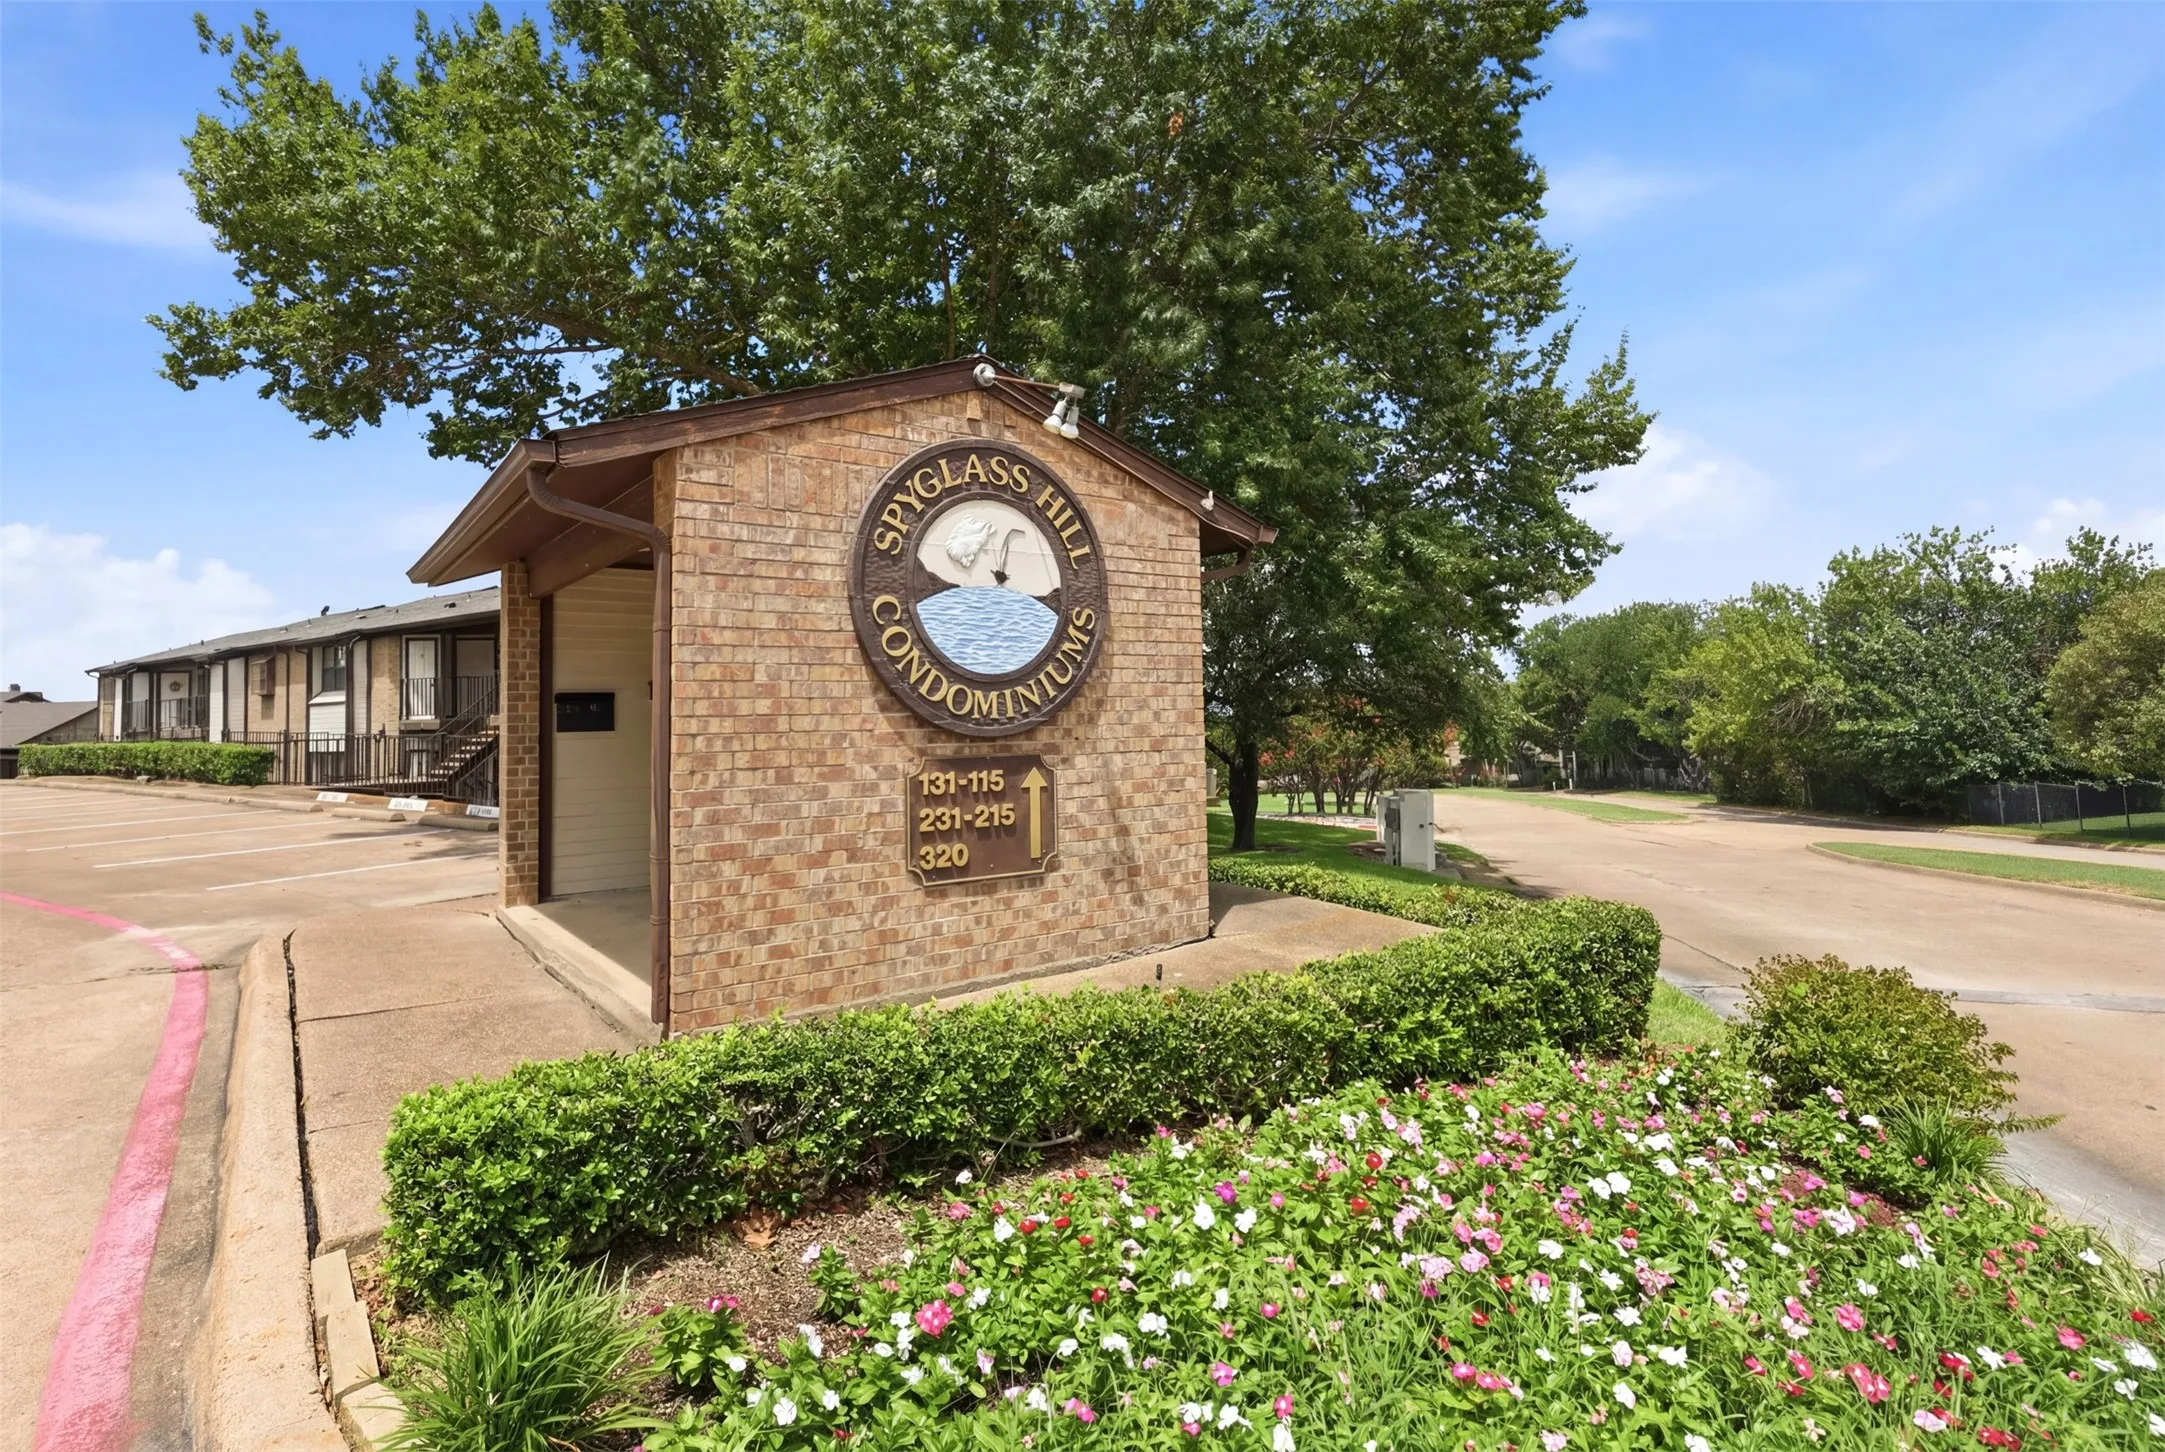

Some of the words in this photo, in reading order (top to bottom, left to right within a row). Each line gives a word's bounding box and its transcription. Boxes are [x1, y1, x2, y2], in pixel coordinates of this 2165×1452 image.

[874, 453, 1030, 556] SPYGLASS
[1035, 485, 1091, 569] HILL
[872, 594, 1096, 719] CONDOMINIUMS
[919, 769, 1005, 796] 131-115
[919, 803, 1016, 833] 231-215
[919, 843, 969, 871] 320
